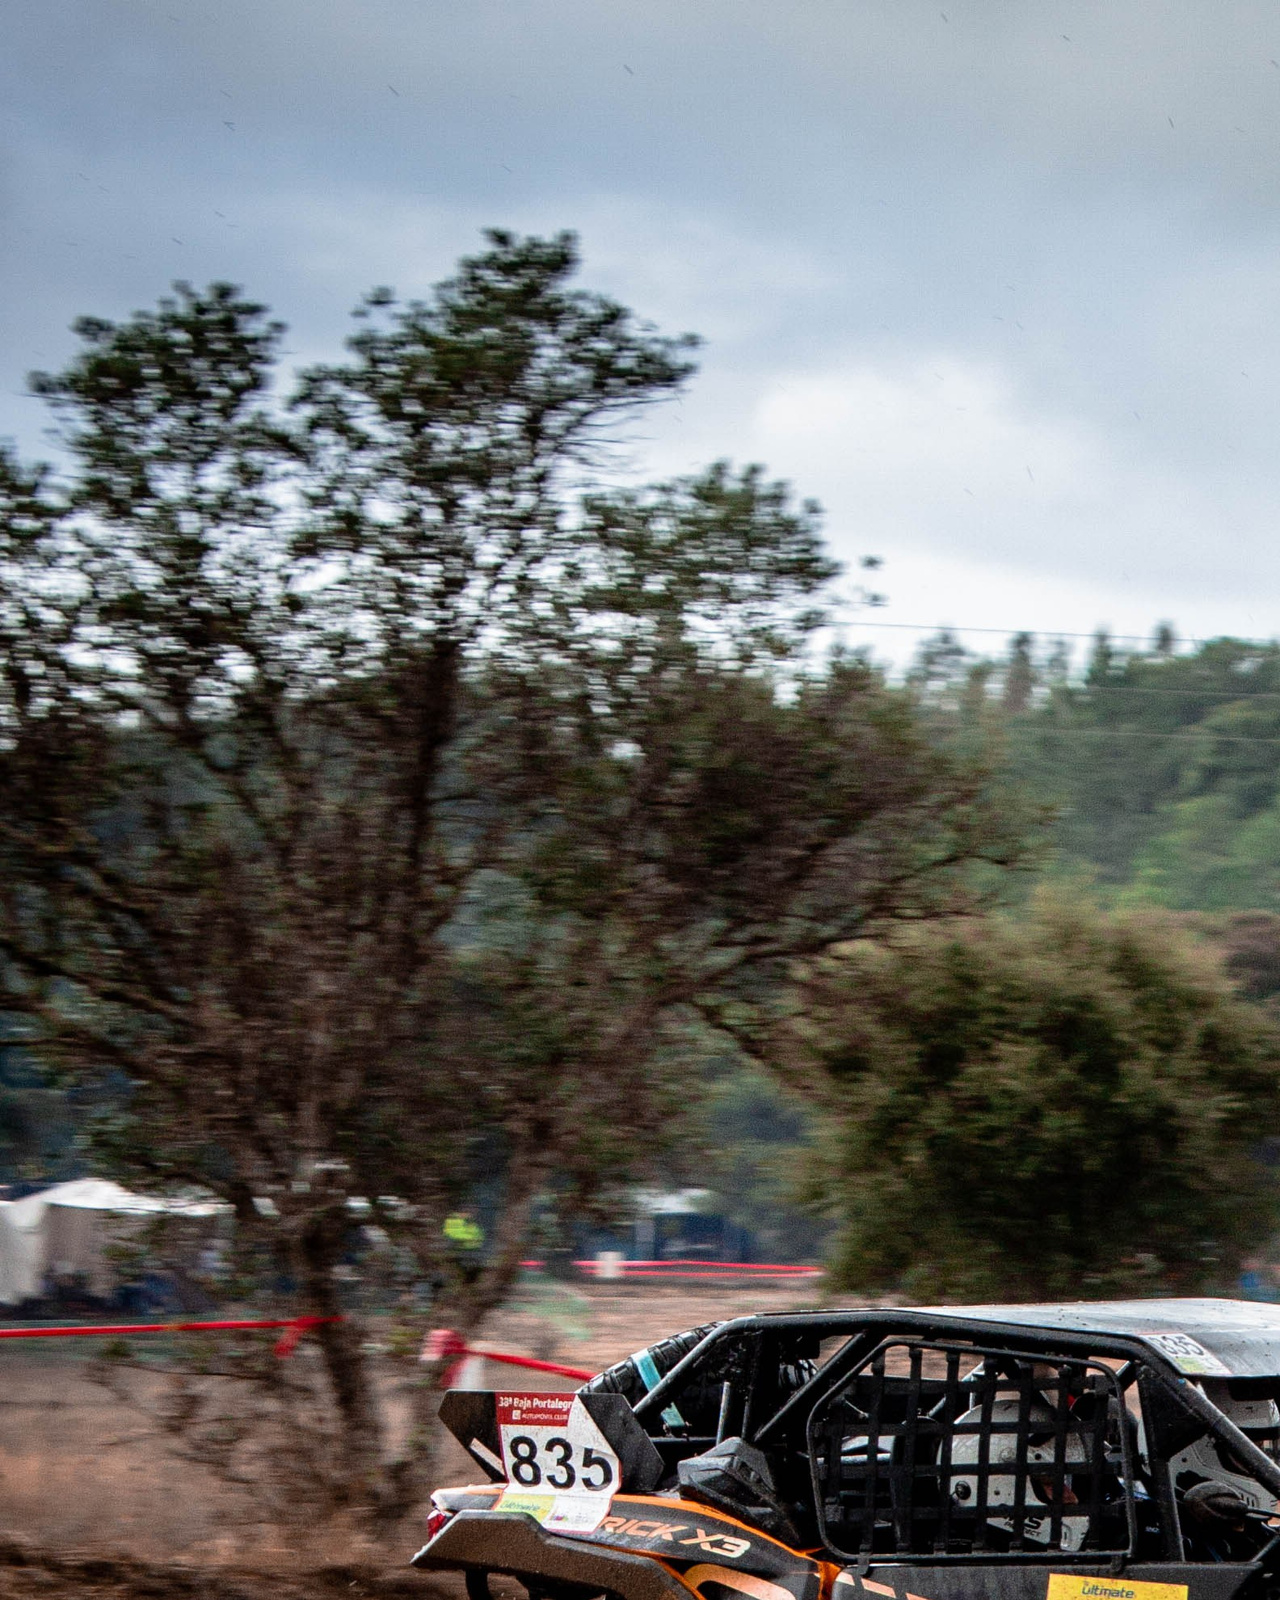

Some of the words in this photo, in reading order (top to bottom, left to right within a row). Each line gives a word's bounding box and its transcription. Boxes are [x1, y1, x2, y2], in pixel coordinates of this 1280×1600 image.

[514, 1397, 532, 1411] Baja
[510, 1436, 613, 1492] 835
[679, 1528, 751, 1558] X3
